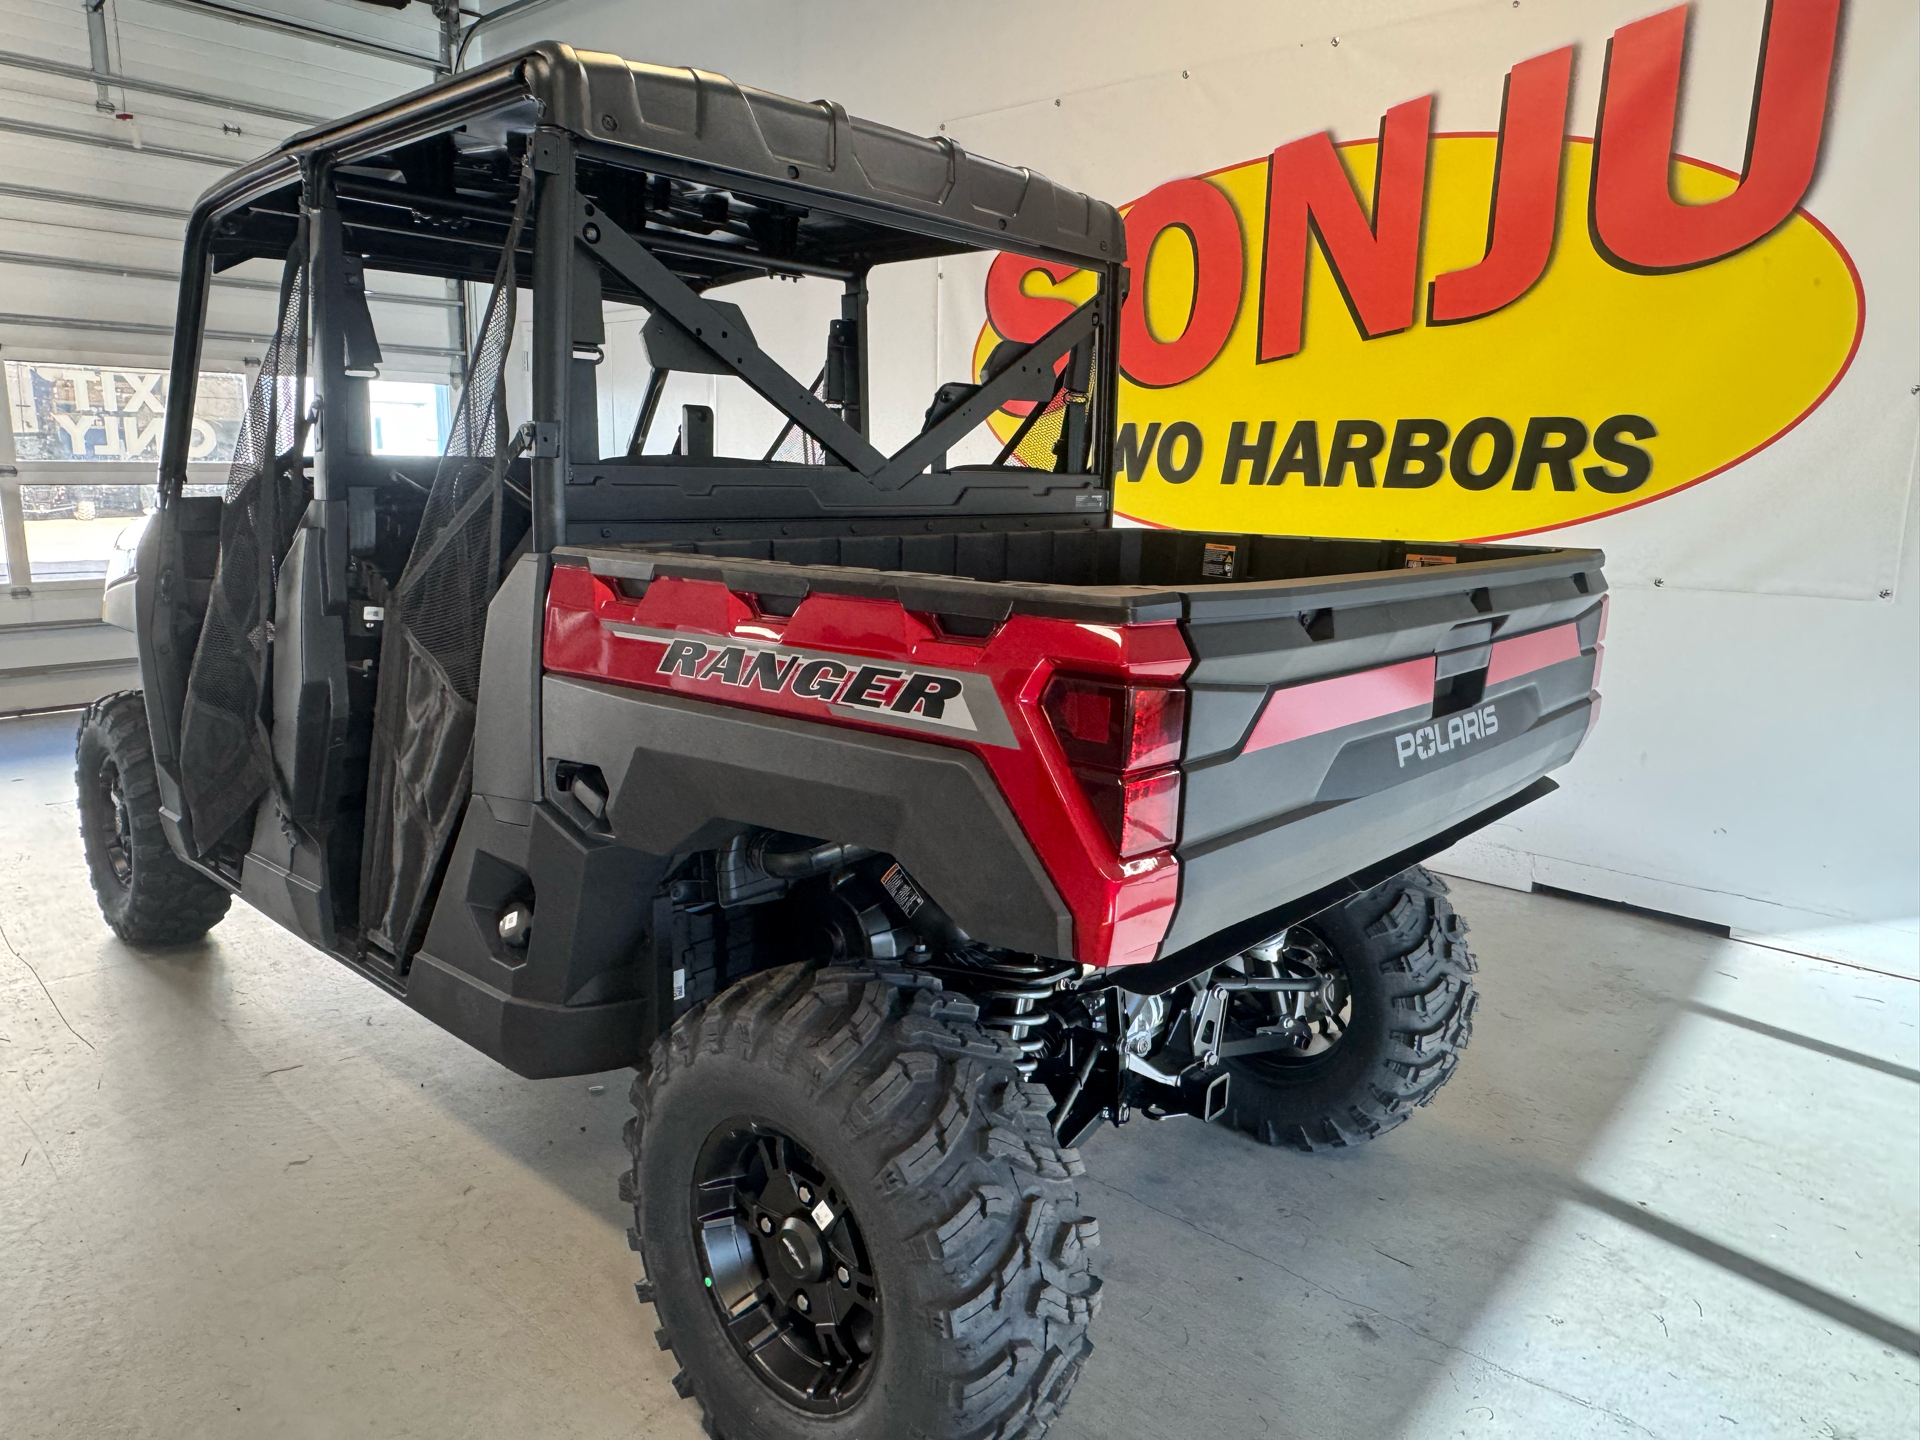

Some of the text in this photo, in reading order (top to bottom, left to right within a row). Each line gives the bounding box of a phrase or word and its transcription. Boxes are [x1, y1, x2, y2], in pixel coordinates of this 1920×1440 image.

[1113, 414, 1657, 493] WO HARBORS
[656, 638, 963, 720] RANGER
[1395, 704, 1498, 768] POLARIS
